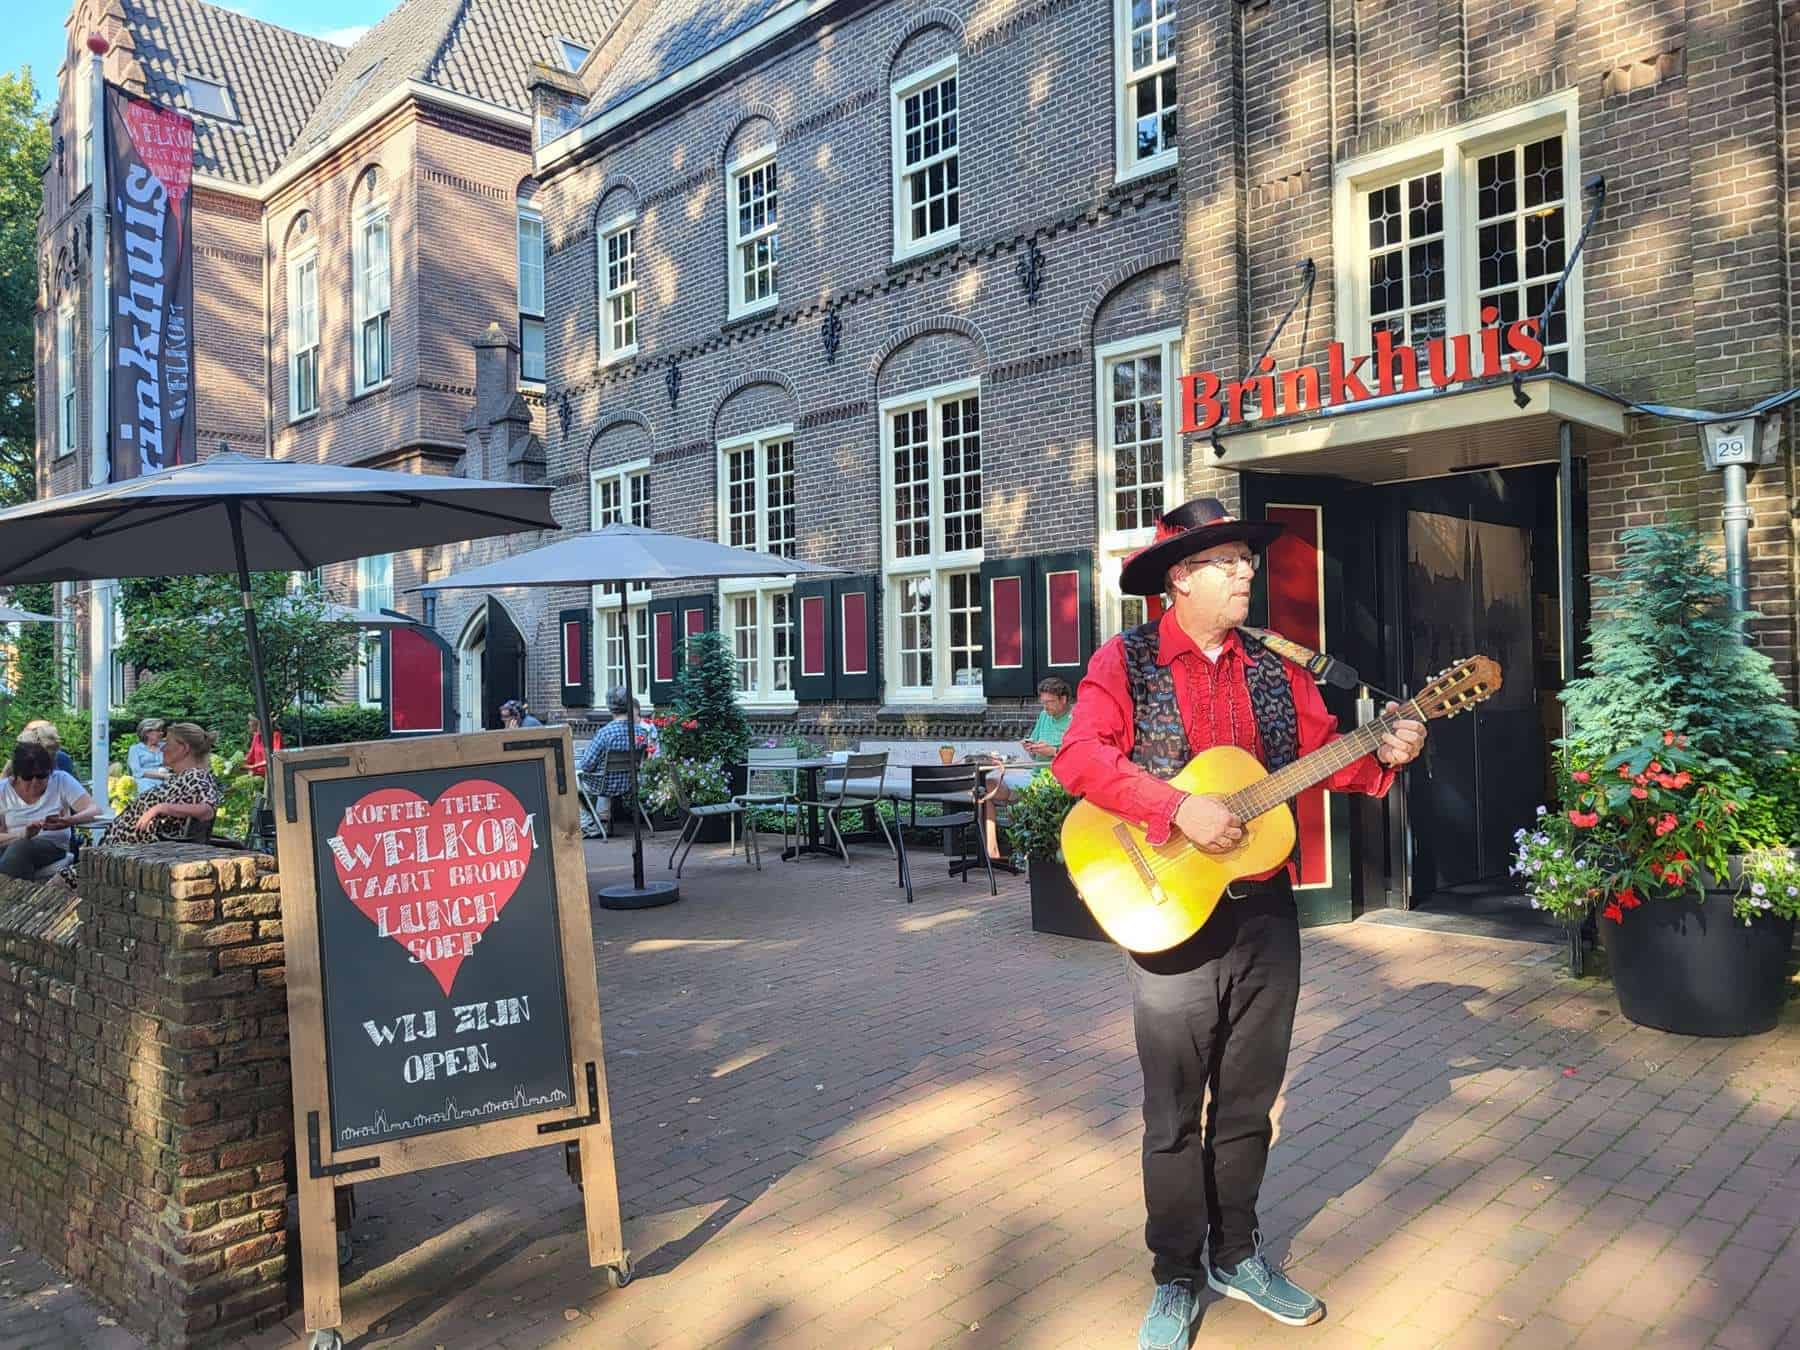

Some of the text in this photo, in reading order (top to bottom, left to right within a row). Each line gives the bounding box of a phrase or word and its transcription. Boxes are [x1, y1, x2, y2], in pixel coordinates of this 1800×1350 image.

[118, 163, 166, 474] rinkhuis
[1177, 306, 1544, 433] Brinkhuis
[1718, 440, 1743, 457] 29
[345, 793, 500, 825] KOFFIE THEE
[327, 813, 539, 872] WELKOM
[344, 859, 526, 900] TAART BROOD
[376, 892, 500, 937] LUNCH
[407, 931, 482, 963] SOEP
[363, 996, 531, 1047] WIJ ZIJN
